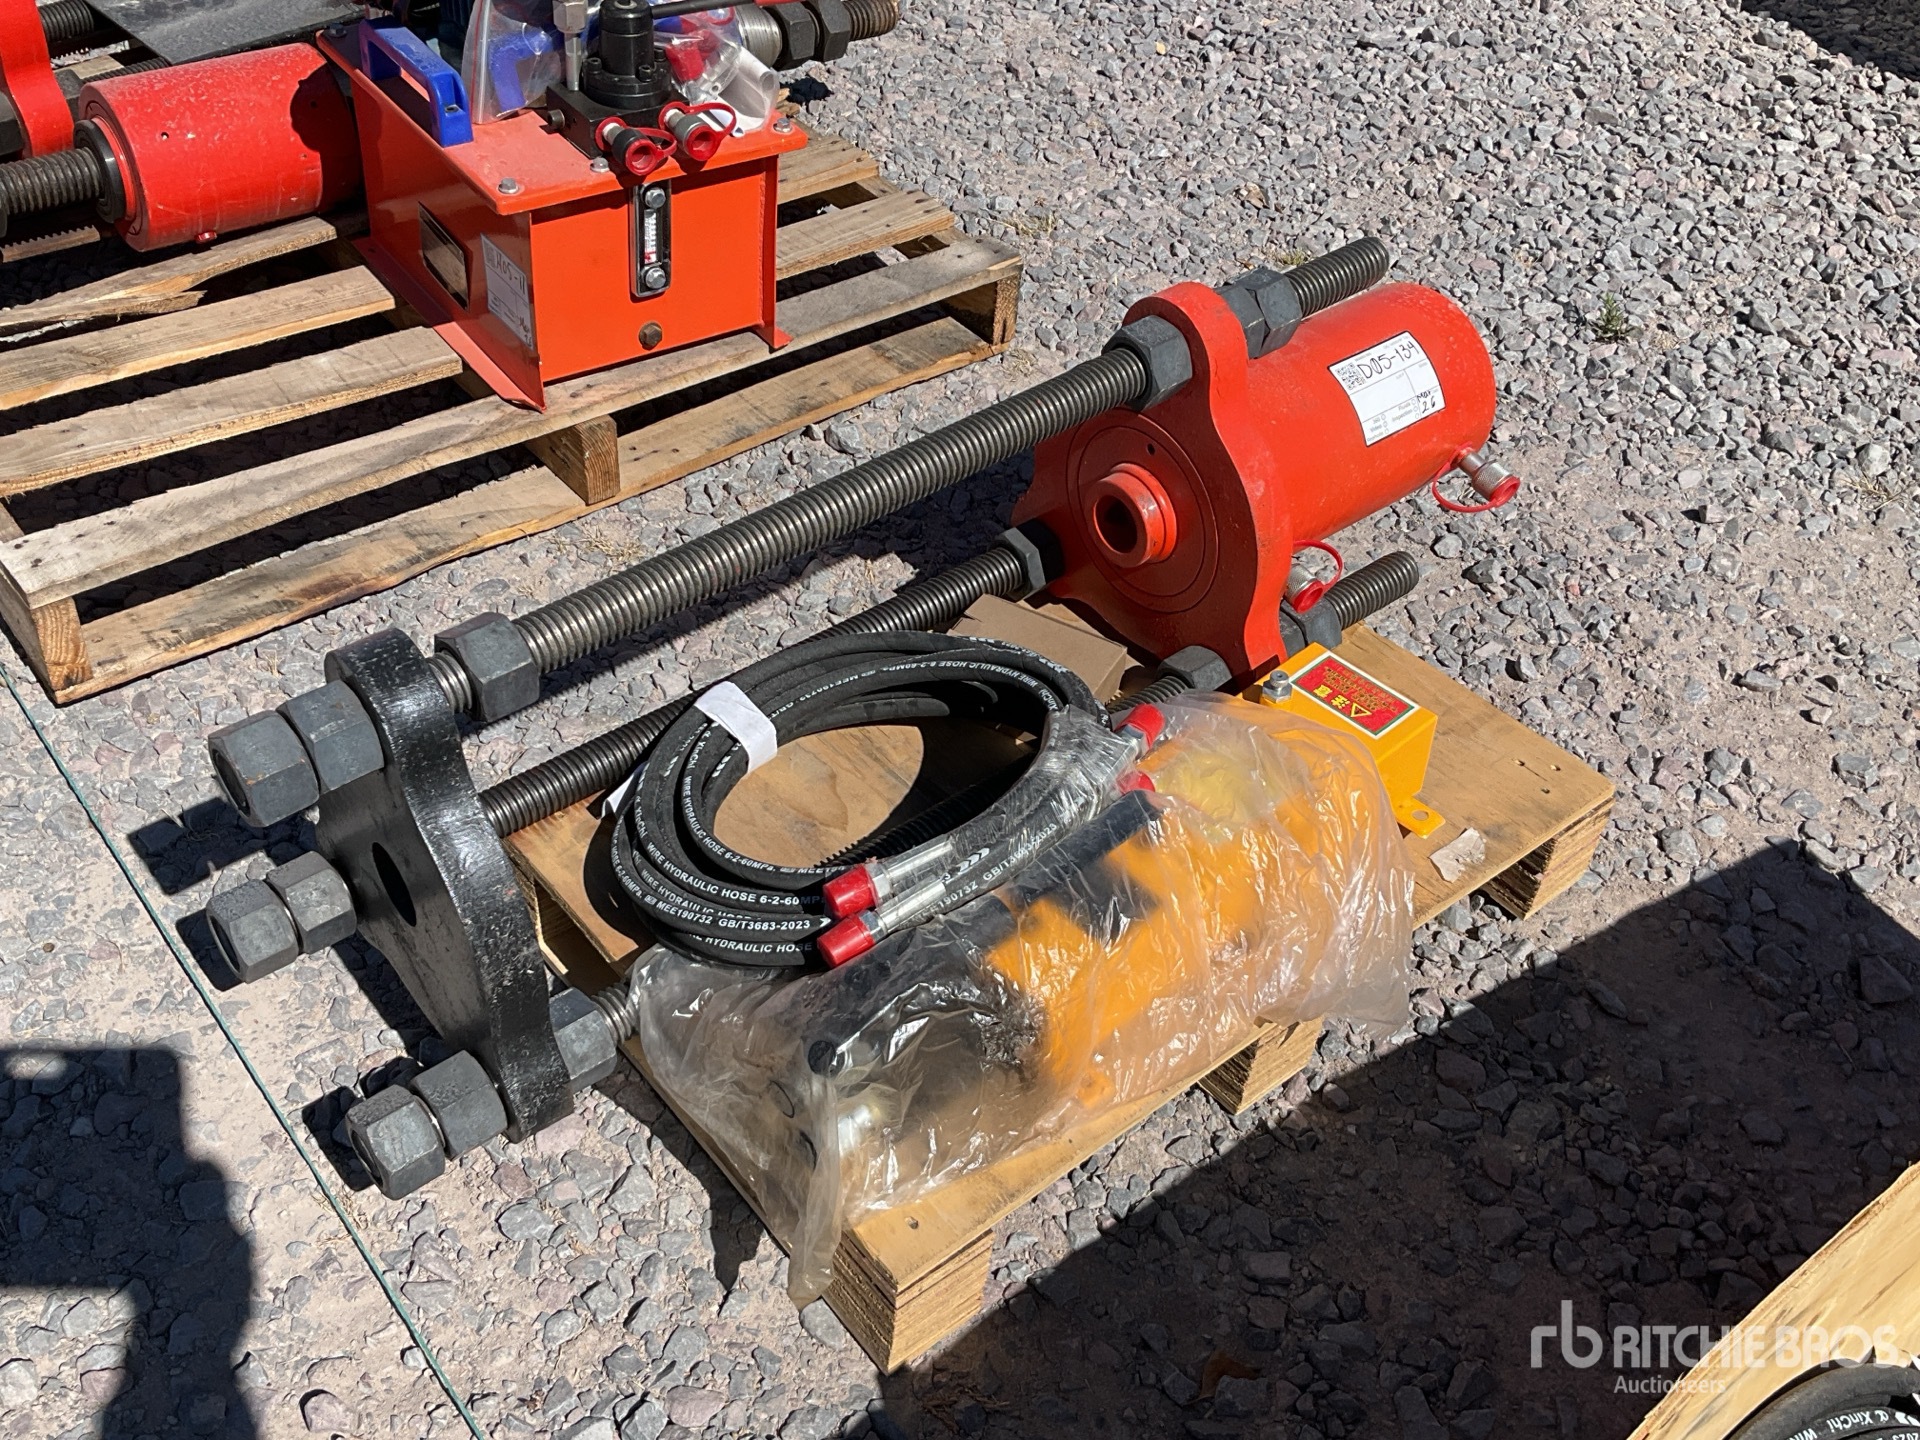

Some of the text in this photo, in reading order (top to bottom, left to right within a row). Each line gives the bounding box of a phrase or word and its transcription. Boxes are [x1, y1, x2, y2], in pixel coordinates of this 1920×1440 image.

[1357, 340, 1420, 379] D05-134
[1422, 395, 1436, 414] 26
[939, 660, 968, 669] HOSE
[969, 662, 1020, 678] HYDRAULIC
[1018, 673, 1038, 688] WIRE
[683, 775, 692, 797] WIRE
[683, 797, 707, 839] HYDRAULIC
[703, 836, 726, 856] HOSE
[641, 869, 659, 890] WIRE
[646, 842, 666, 865] WIRE
[663, 860, 719, 894] HYDRAULIC
[721, 887, 757, 903] HOSE
[656, 900, 713, 925] MEE190732
[718, 918, 811, 931] GB/T3683-2023
[705, 937, 773, 953] HYDRAULIC
[1826, 1410, 1874, 1433] XinChi
